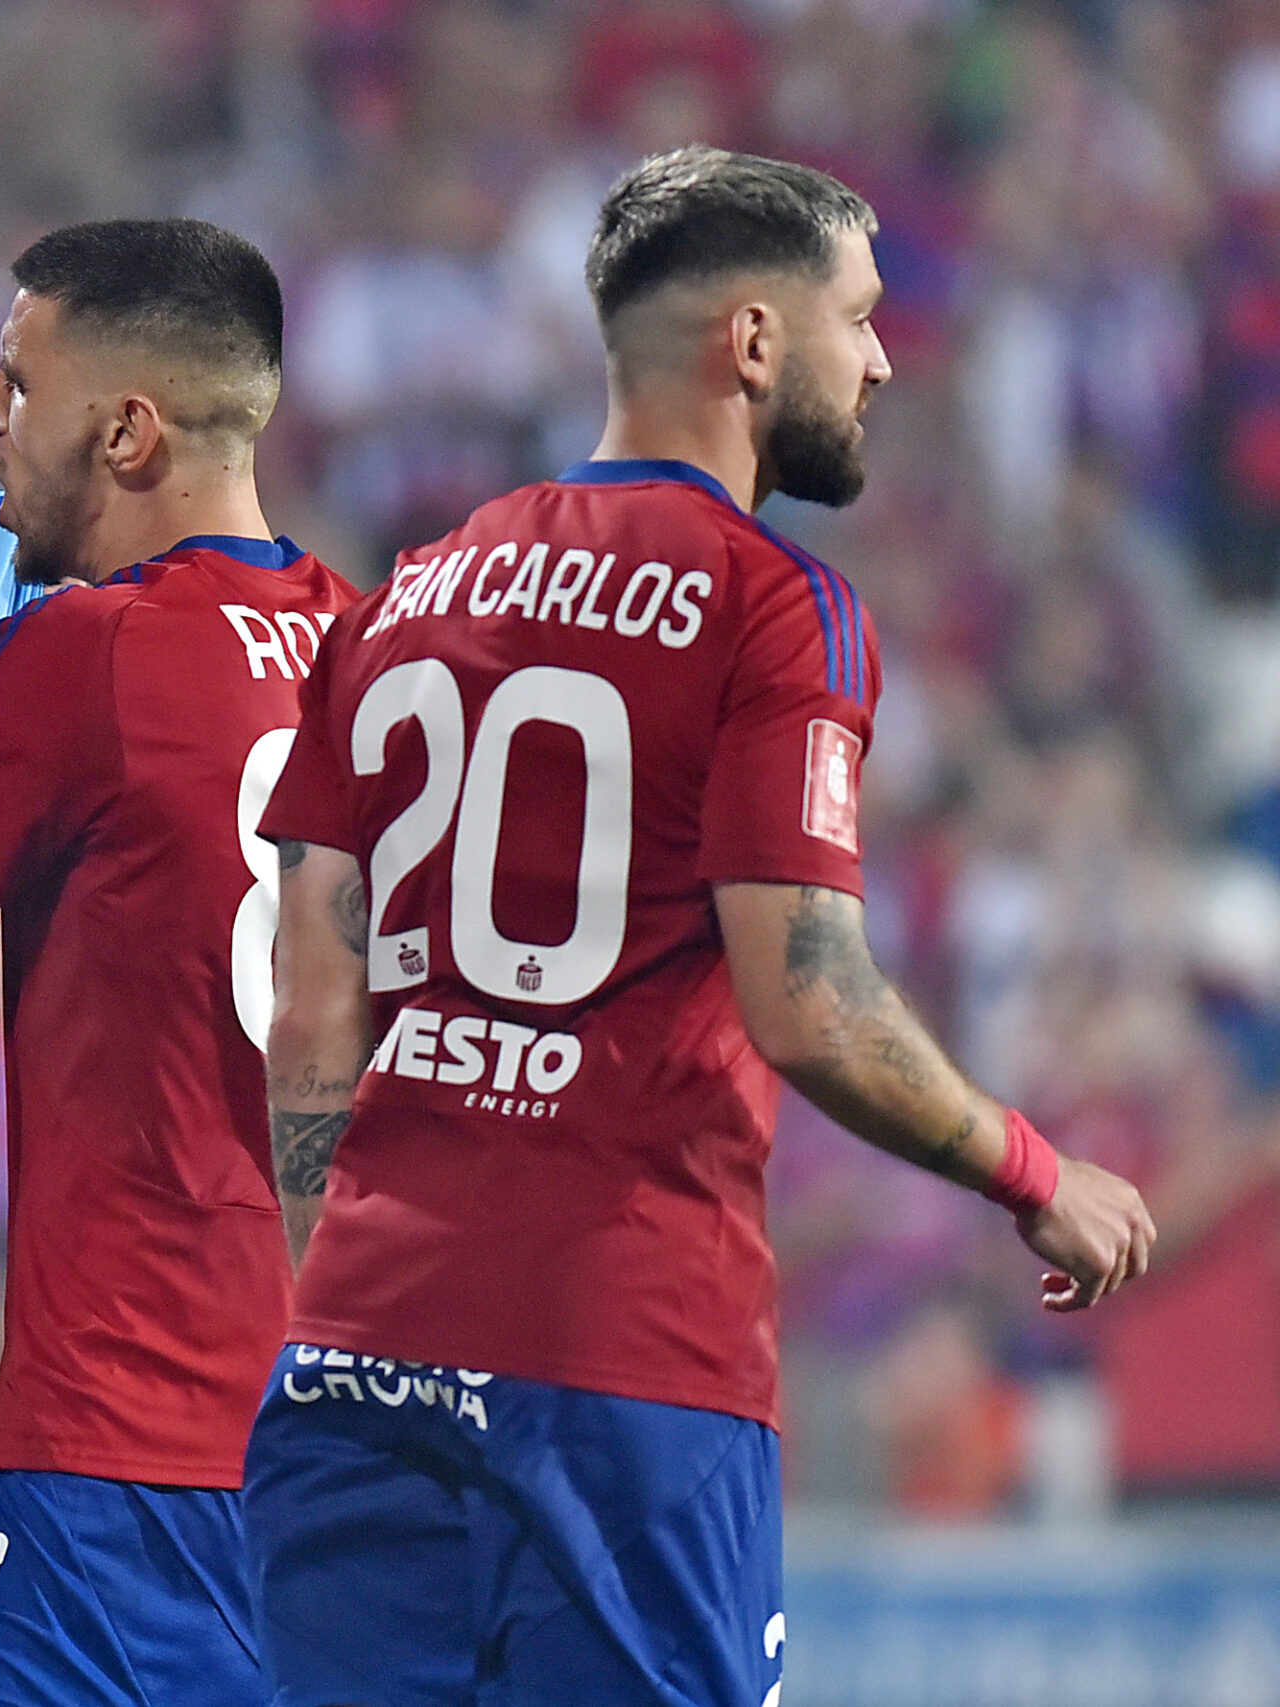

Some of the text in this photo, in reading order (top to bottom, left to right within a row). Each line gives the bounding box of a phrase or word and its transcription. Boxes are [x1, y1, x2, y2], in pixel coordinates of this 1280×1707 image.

[468, 541, 713, 649] CARLOS
[352, 657, 633, 1006] 20
[464, 1092, 560, 1118] ENERGY
